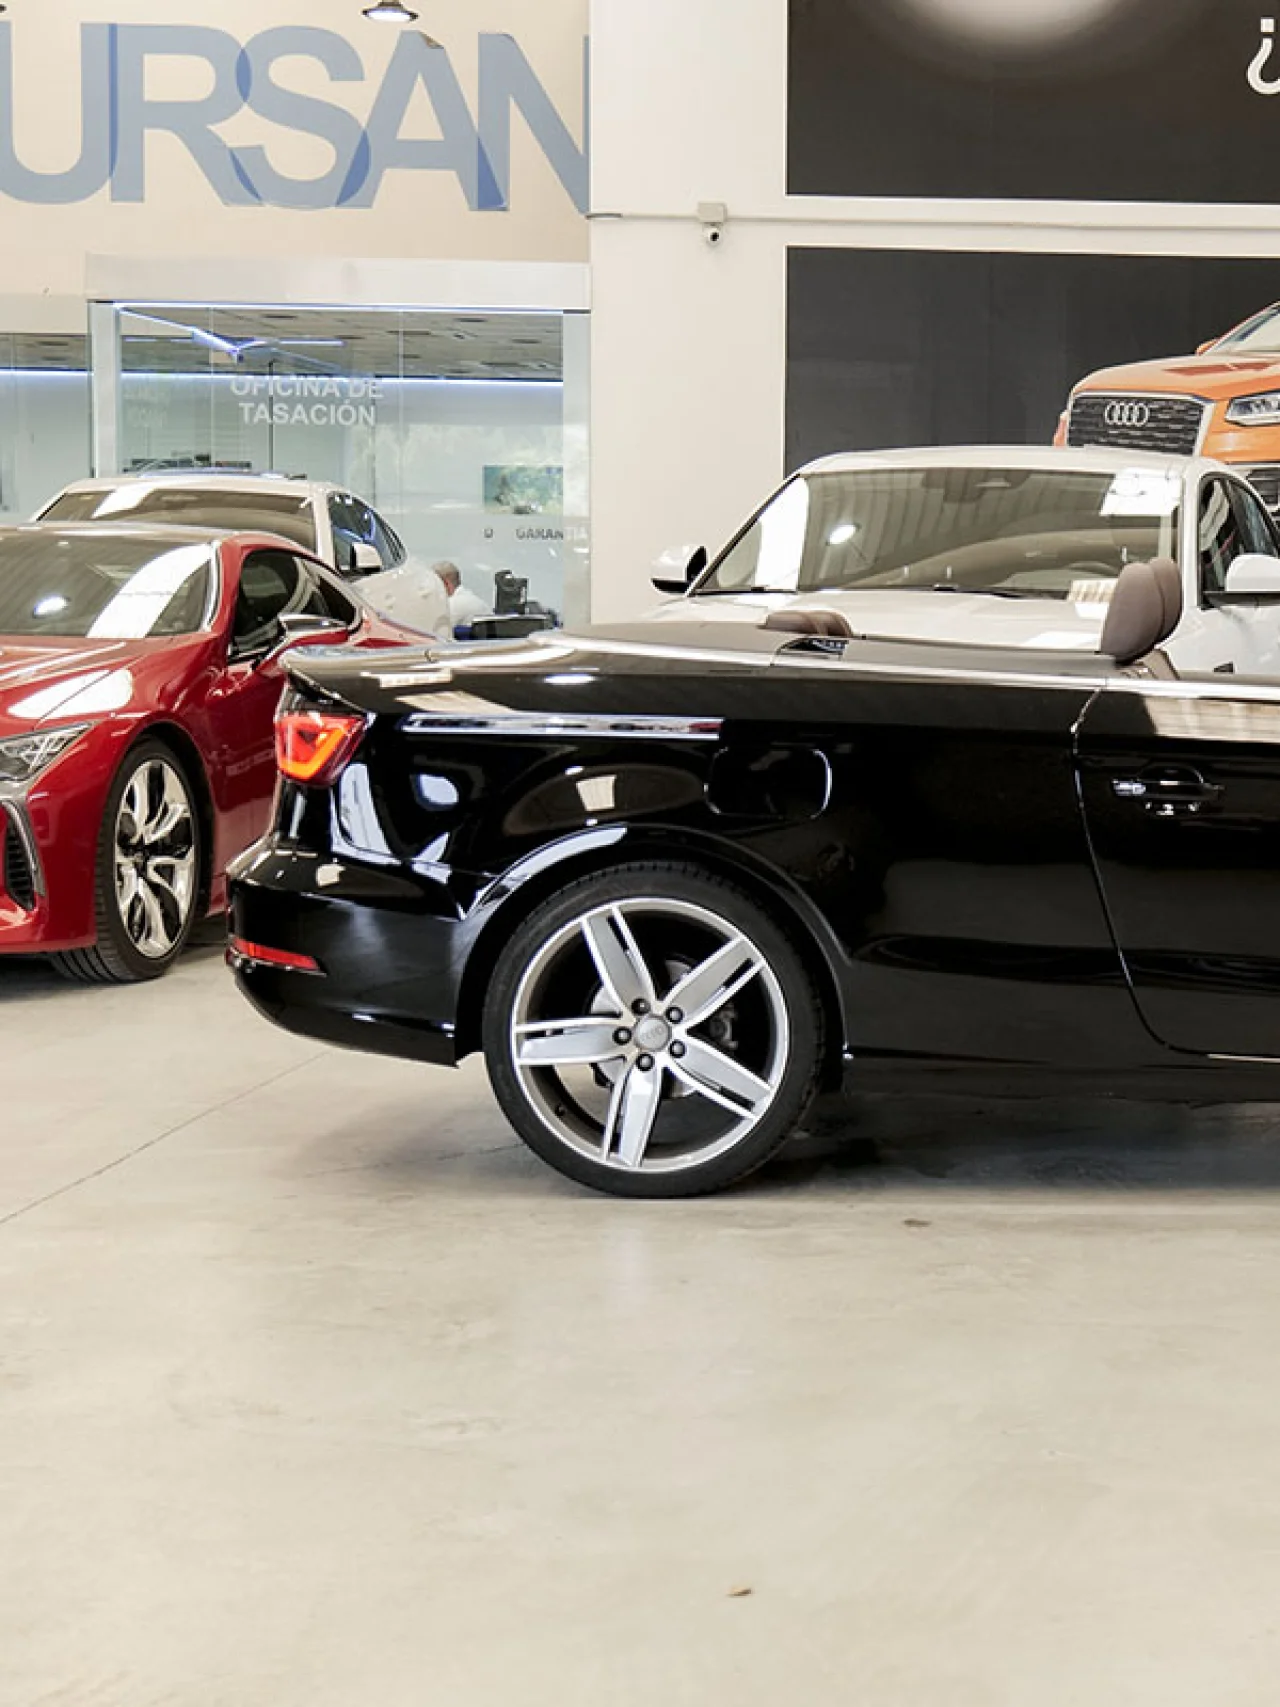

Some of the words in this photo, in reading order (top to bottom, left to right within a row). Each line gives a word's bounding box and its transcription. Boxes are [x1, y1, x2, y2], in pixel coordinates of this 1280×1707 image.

[230, 376, 341, 398] OFICINA
[349, 378, 384, 398] DE
[238, 399, 376, 426] TASACIÓN
